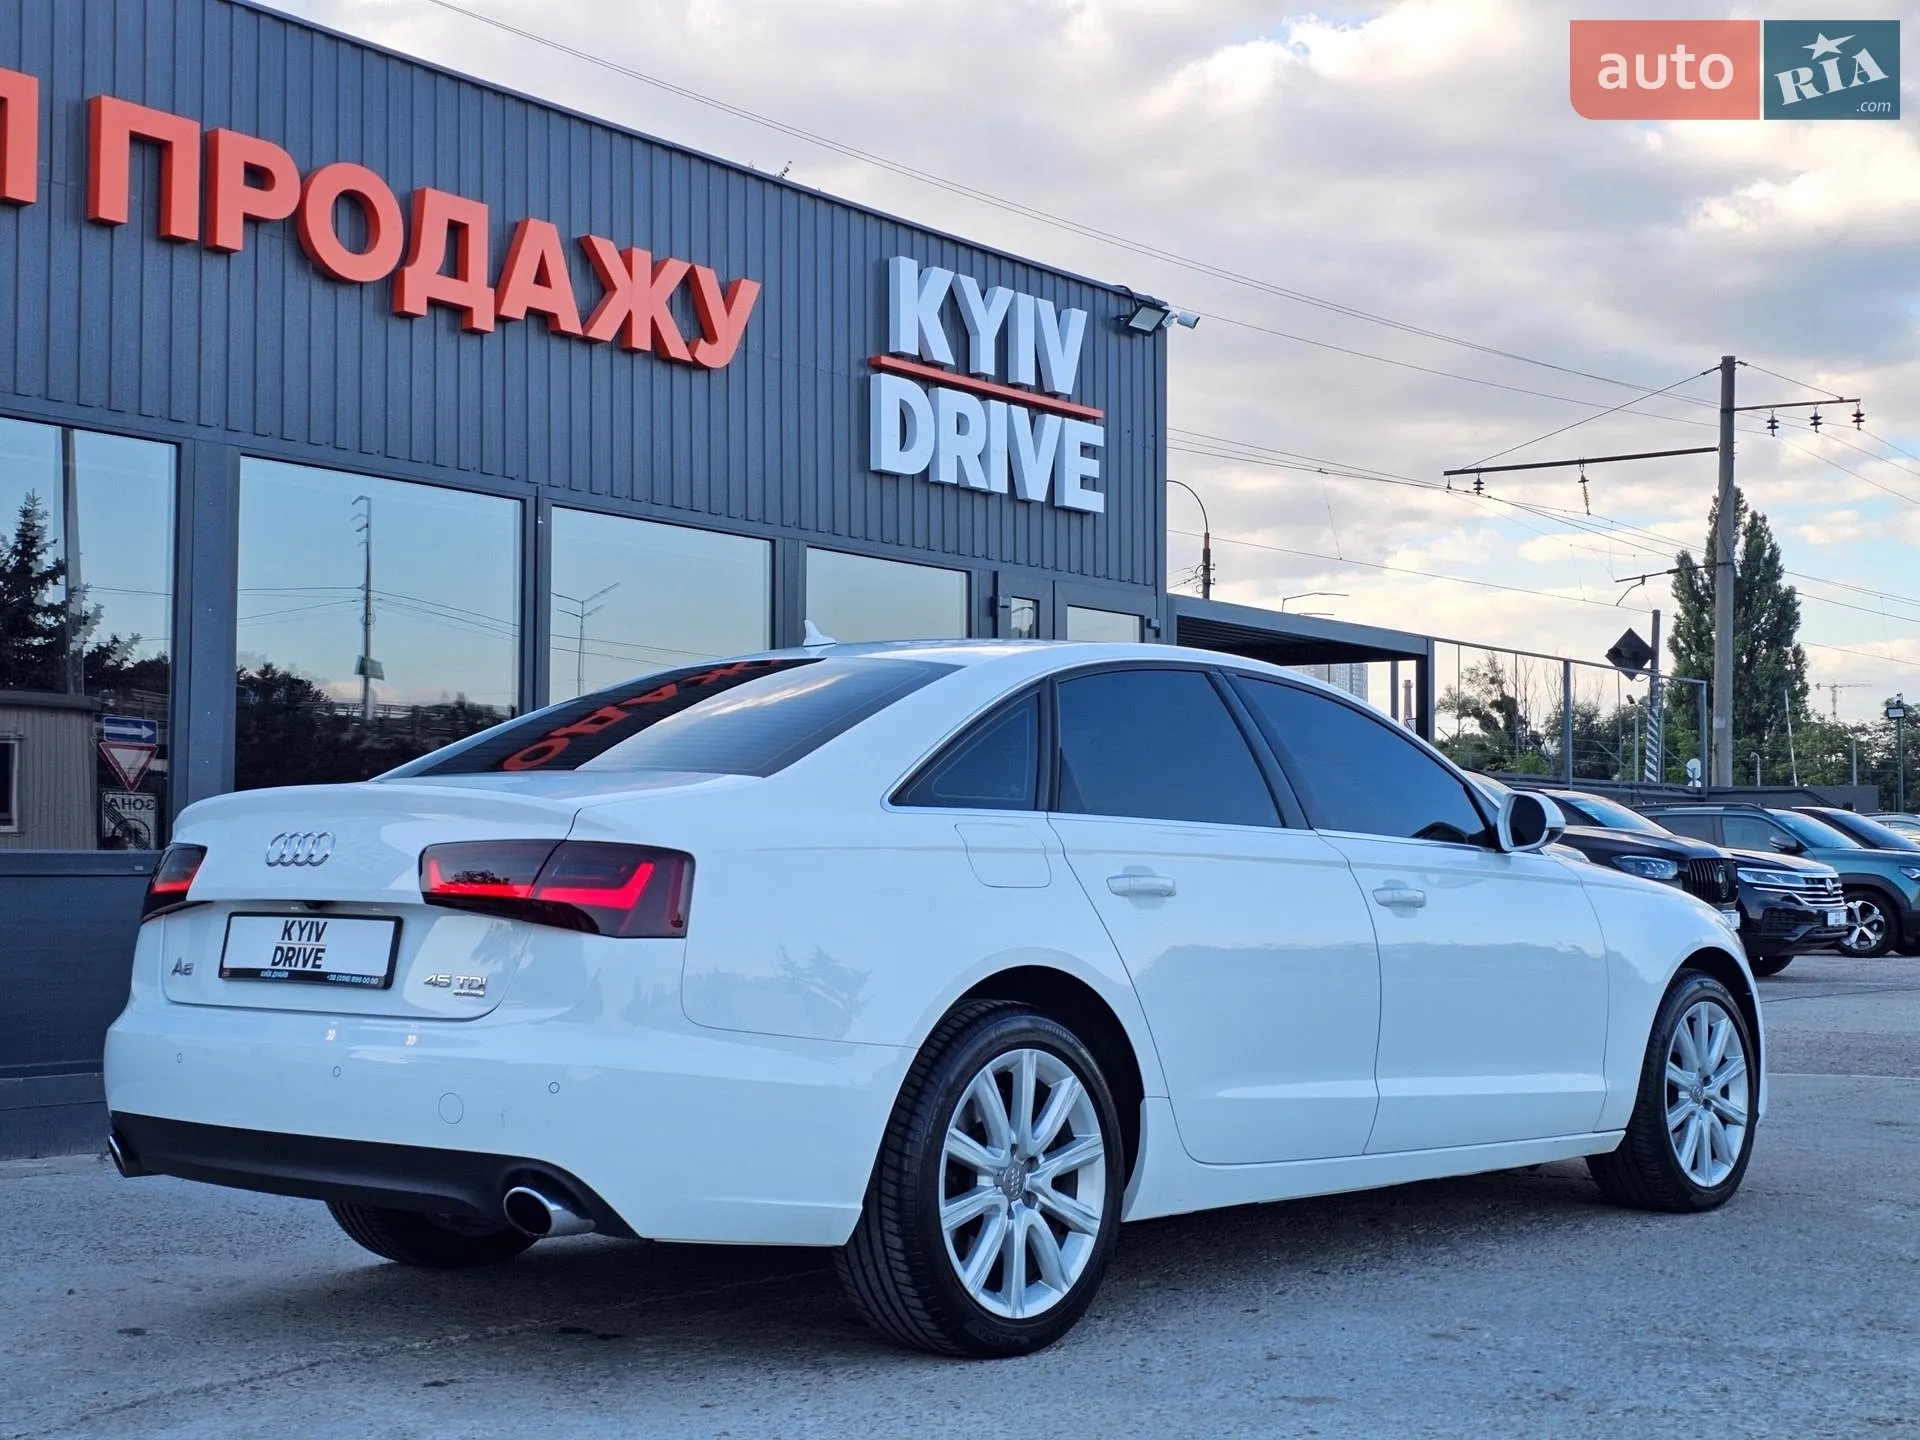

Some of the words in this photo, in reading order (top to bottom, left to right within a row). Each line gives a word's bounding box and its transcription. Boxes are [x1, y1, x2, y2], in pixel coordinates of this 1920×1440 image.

[88, 95, 761, 369] ПРОДАЖУ
[889, 256, 1087, 395] KYIV
[870, 373, 1104, 513] DRIVE
[281, 919, 327, 943] KYIV
[171, 957, 194, 976] A6
[270, 945, 326, 969] DRIVE
[424, 974, 452, 988] 45
[455, 976, 488, 990] TDI
